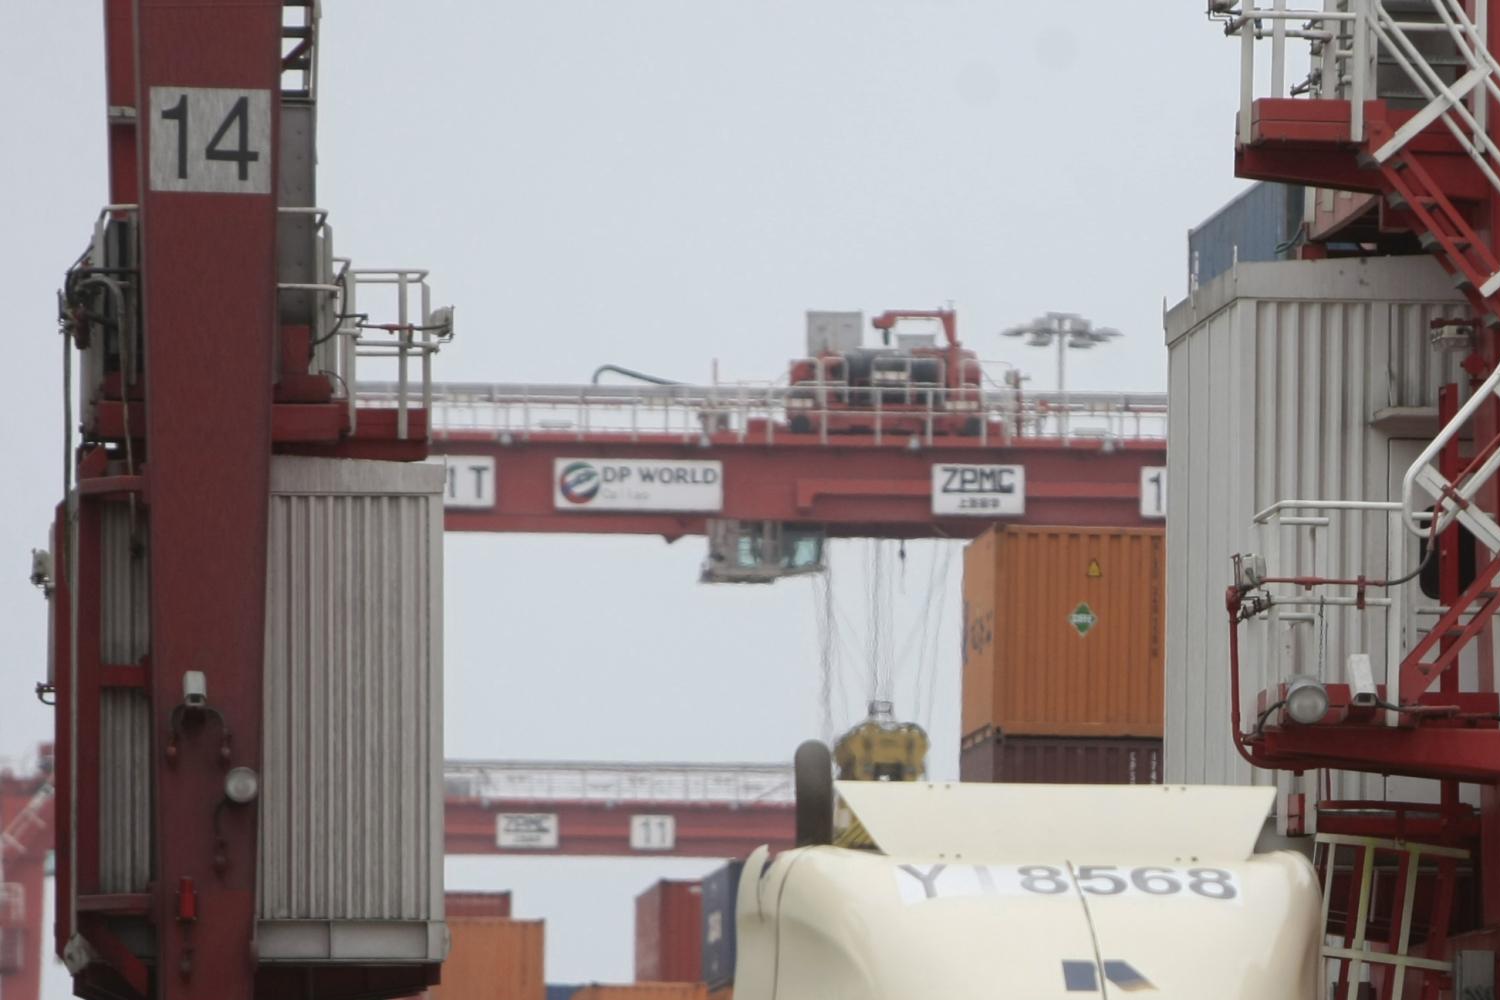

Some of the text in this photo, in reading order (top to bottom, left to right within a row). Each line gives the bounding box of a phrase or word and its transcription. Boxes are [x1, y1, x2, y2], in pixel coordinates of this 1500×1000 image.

[160, 94, 259, 181] 14
[602, 466, 718, 485] DP WORLD
[941, 466, 1015, 494] ZPMC
[1016, 864, 1238, 900] 8568
